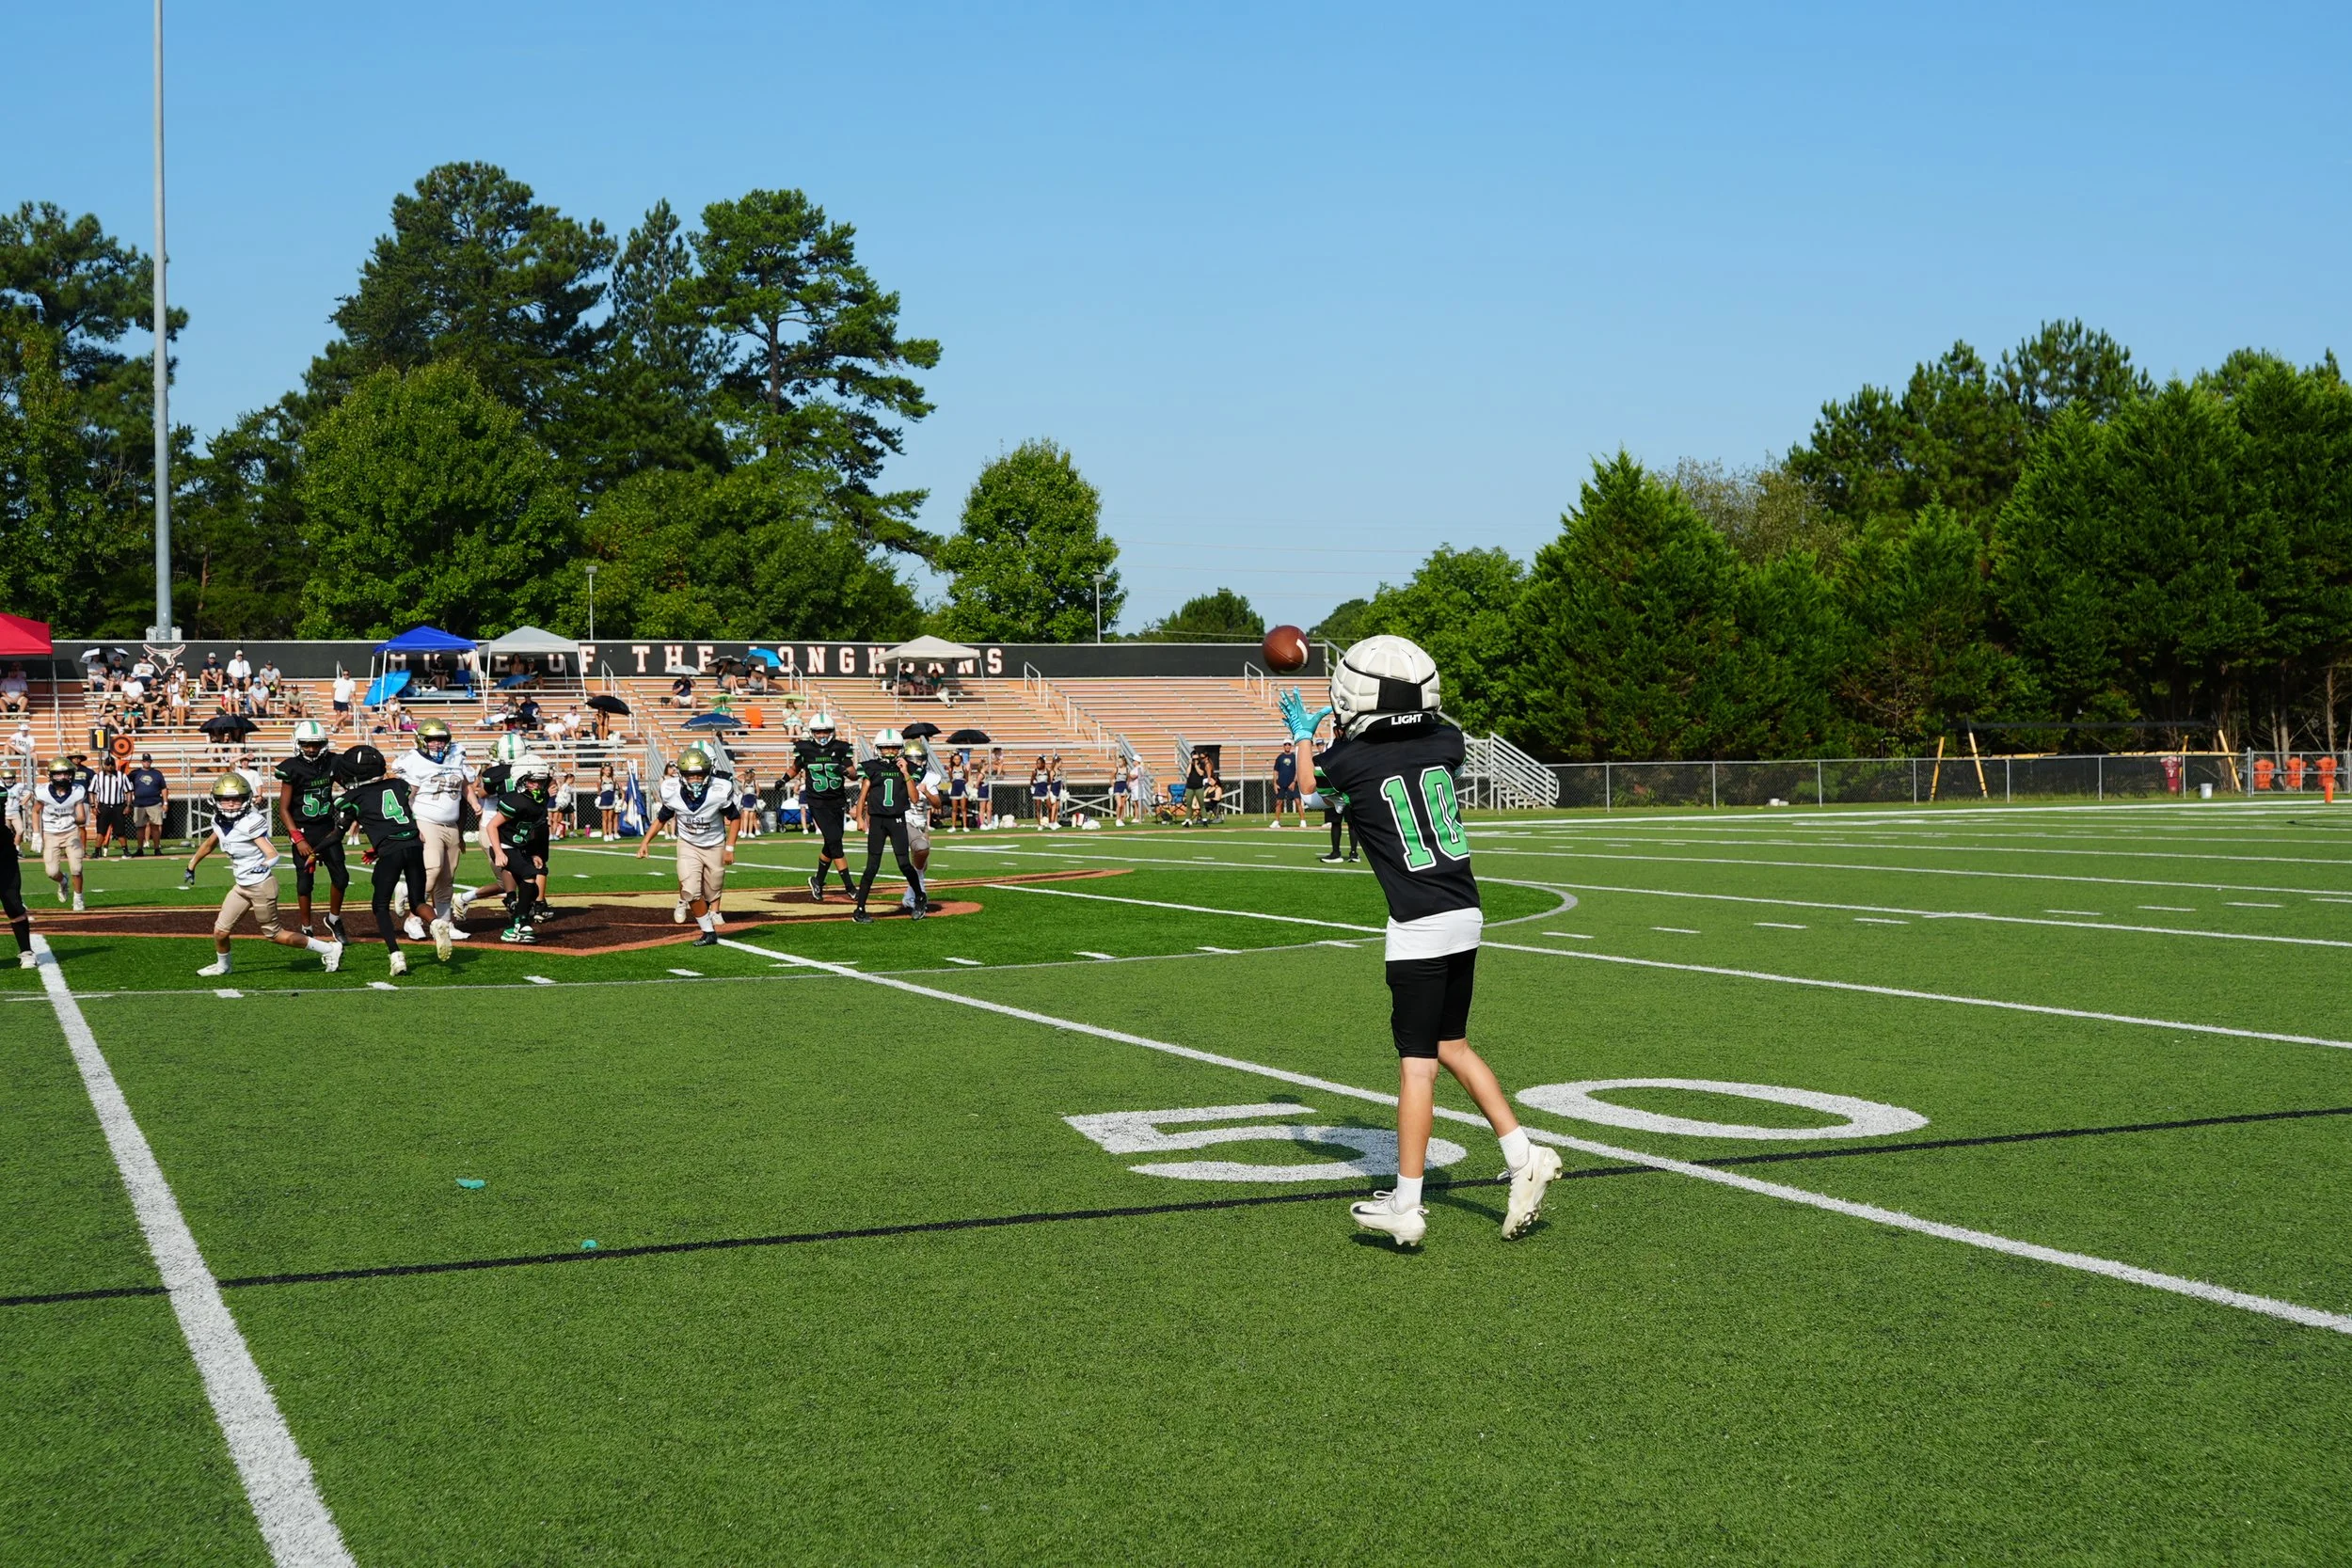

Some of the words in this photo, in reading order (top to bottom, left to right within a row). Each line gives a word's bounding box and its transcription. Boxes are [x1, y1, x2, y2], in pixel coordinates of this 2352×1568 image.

[631, 645, 714, 673] THE
[1391, 713, 1423, 726] LIGHT
[95, 729, 104, 749] 1
[807, 763, 843, 792] 55
[381, 788, 410, 825] 4
[882, 778, 894, 807] 1
[686, 815, 705, 824] WEST
[1380, 765, 1470, 872] 10
